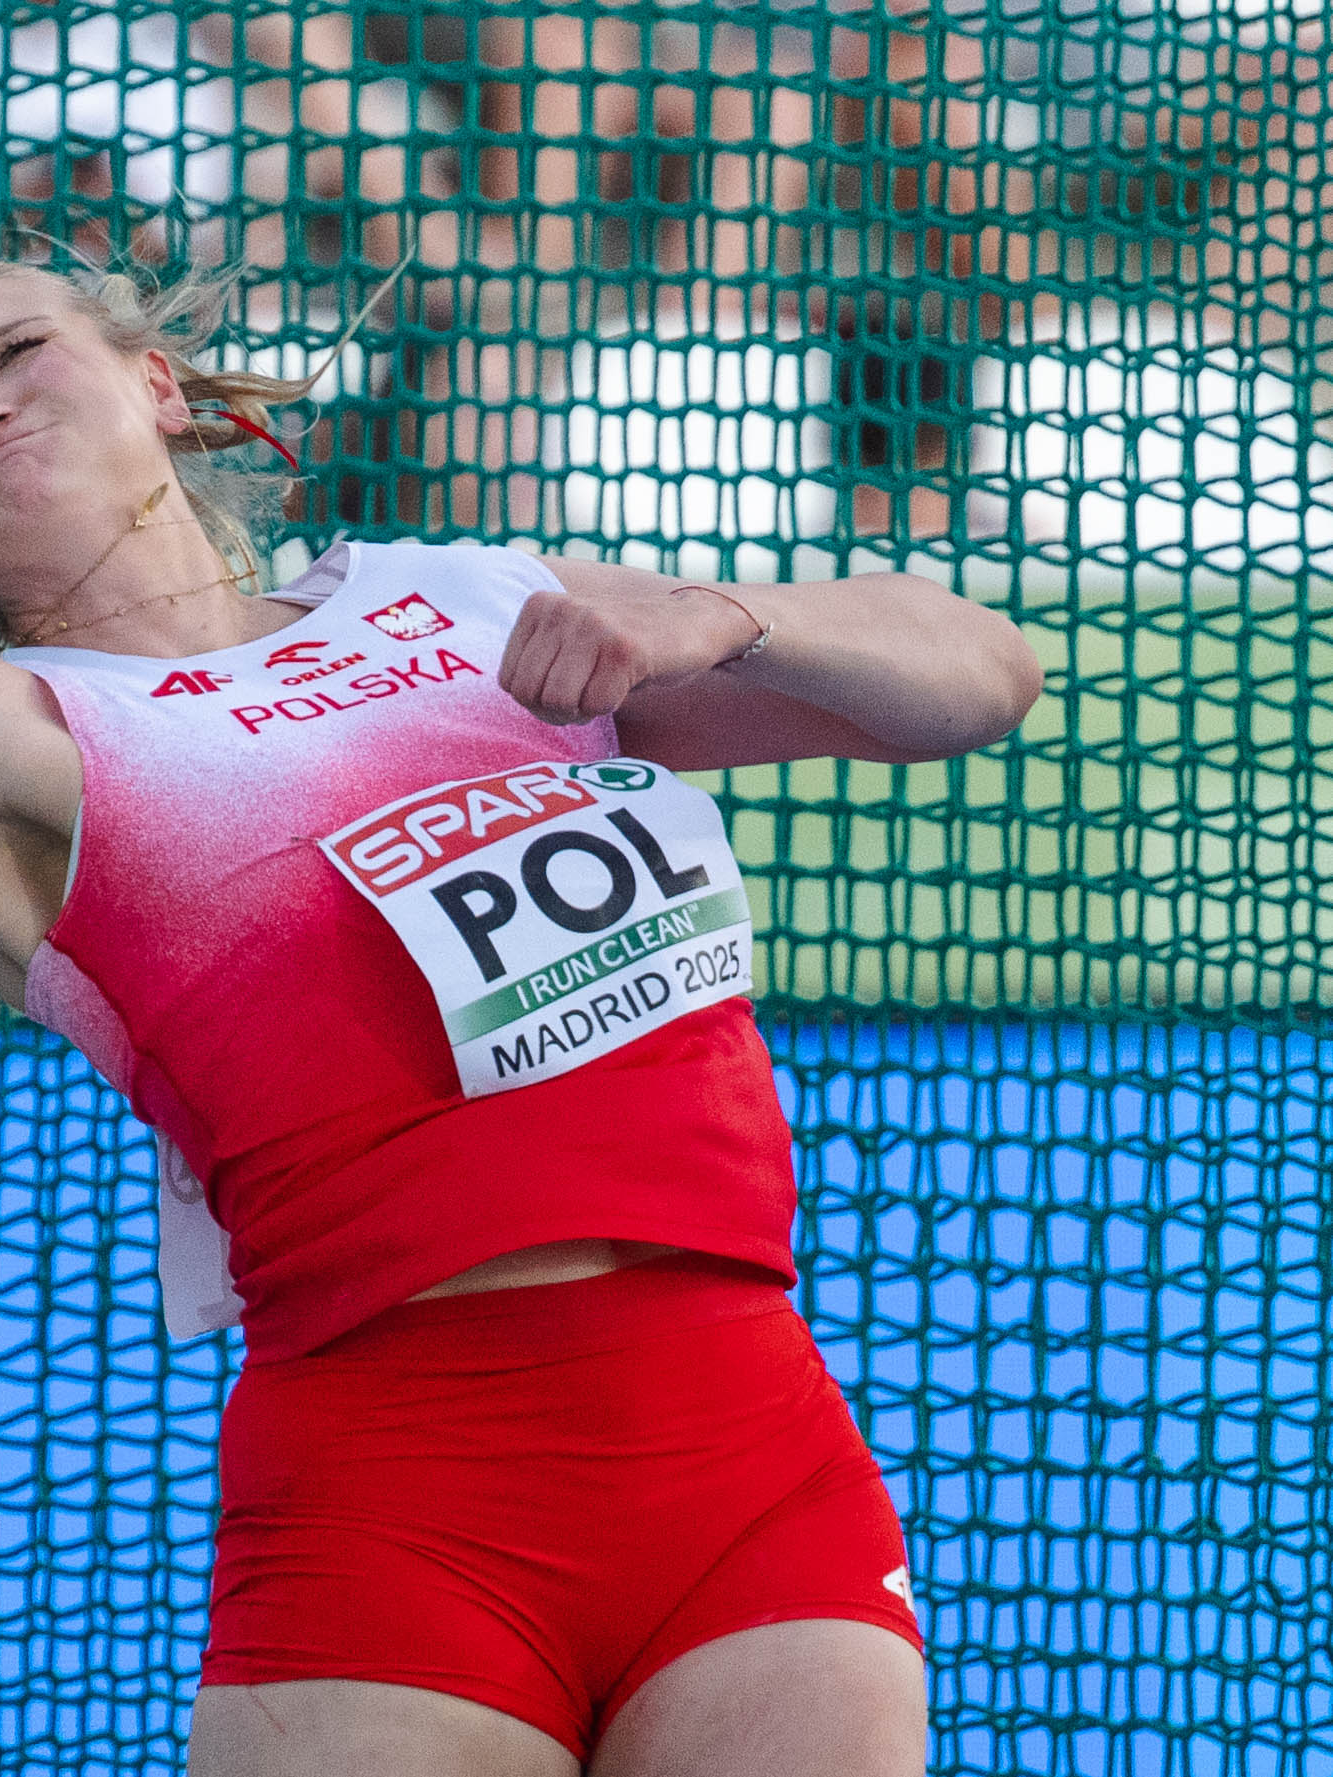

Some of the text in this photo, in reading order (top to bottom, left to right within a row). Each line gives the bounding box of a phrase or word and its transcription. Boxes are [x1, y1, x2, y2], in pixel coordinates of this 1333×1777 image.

[229, 647, 484, 735] POLSKA
[280, 652, 367, 687] ORLEN
[349, 773, 583, 887] SPAR
[430, 806, 711, 984] POL
[491, 940, 740, 1078] MADRID 2025
[515, 985, 530, 1010] I
[531, 951, 597, 1004] RUN
